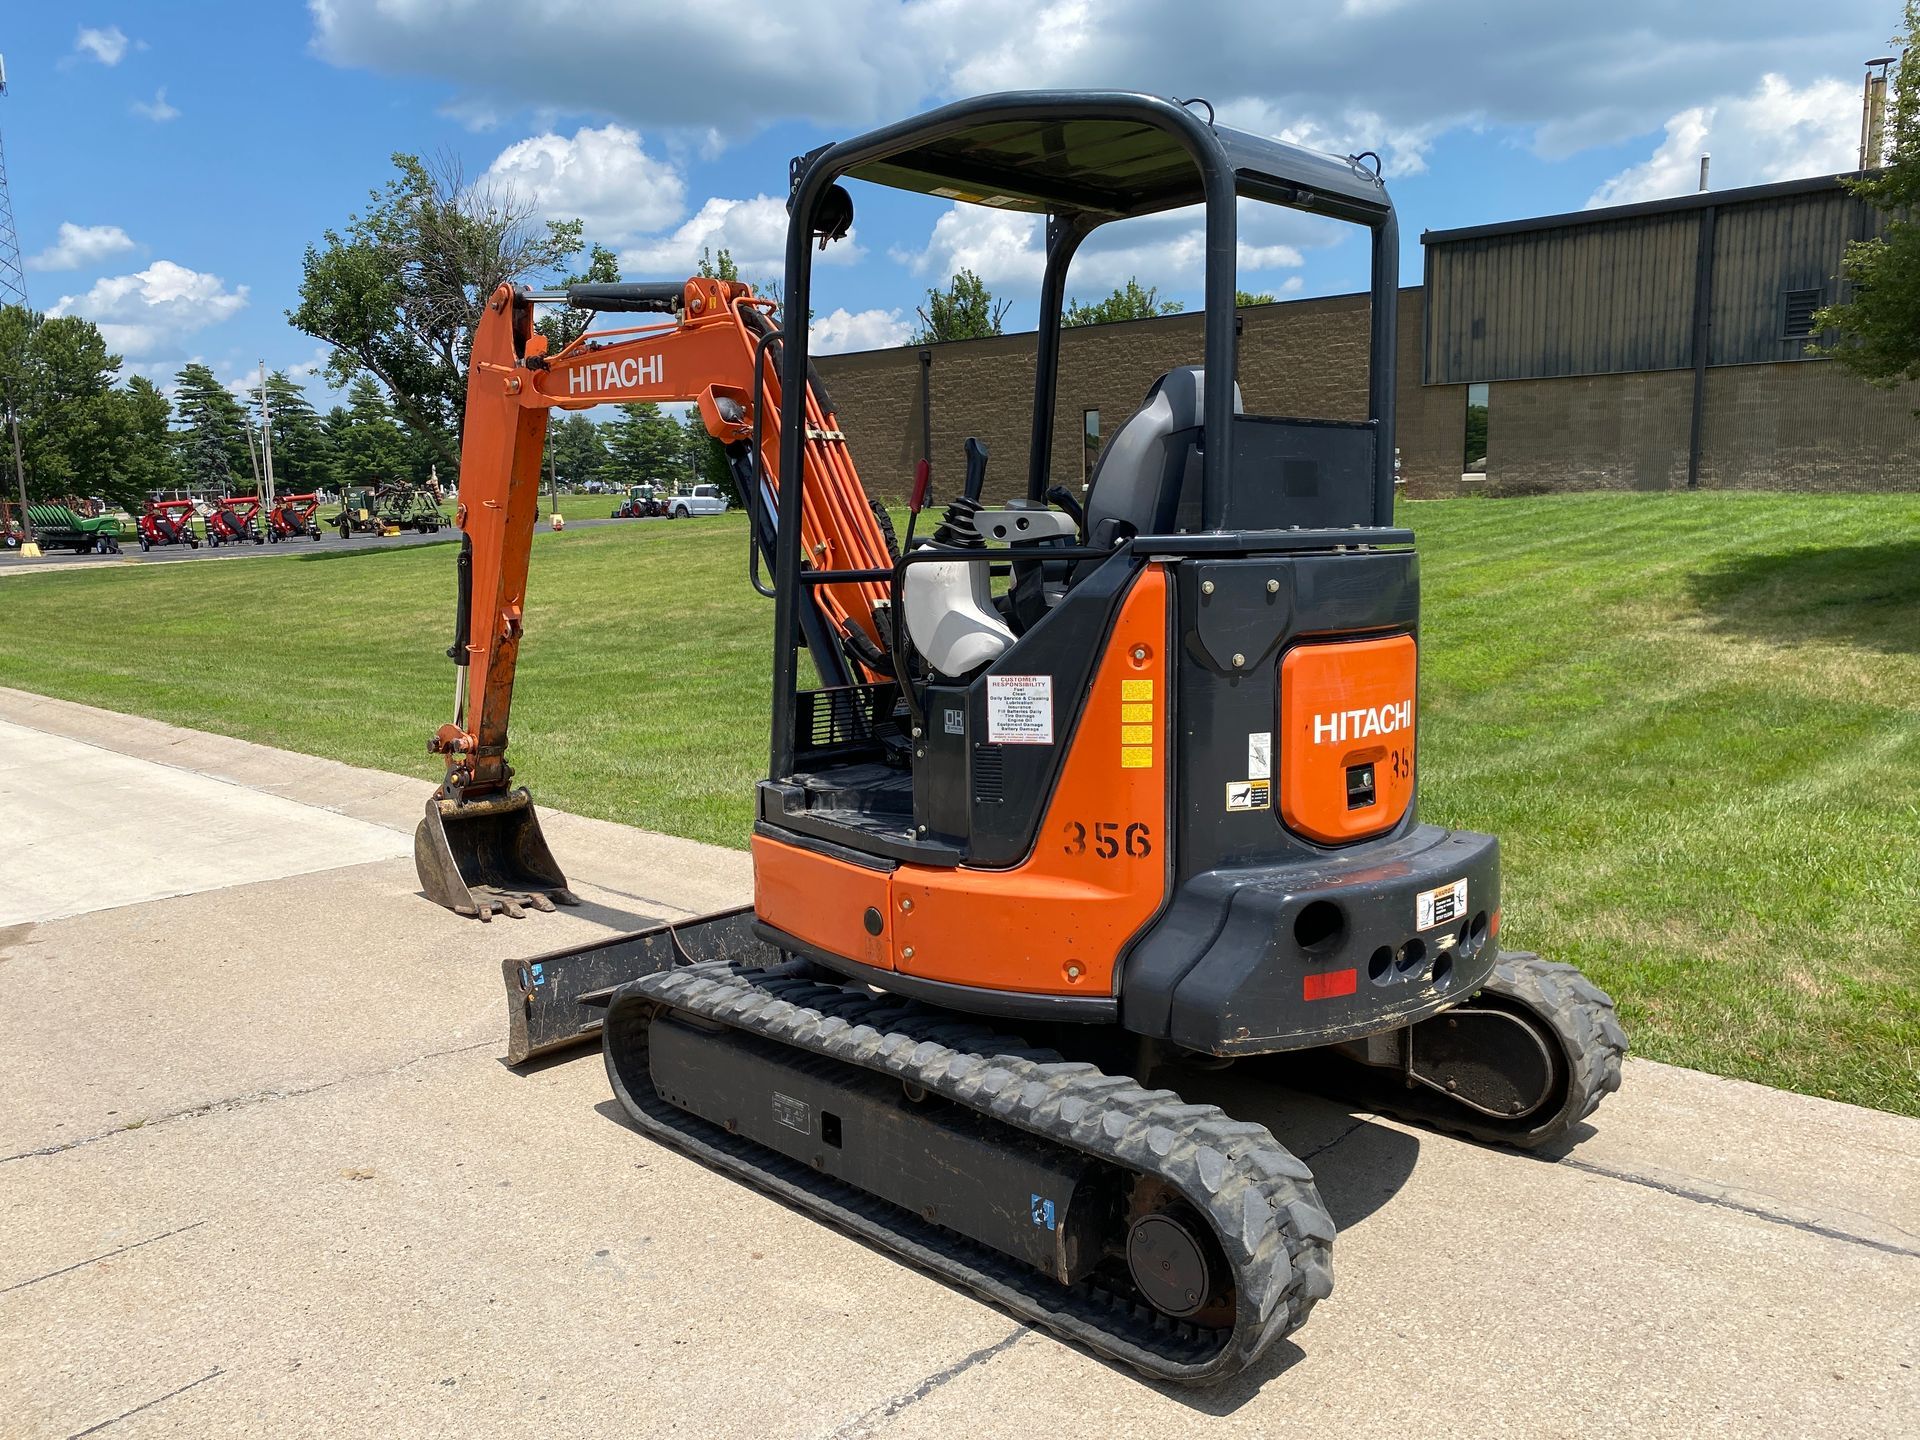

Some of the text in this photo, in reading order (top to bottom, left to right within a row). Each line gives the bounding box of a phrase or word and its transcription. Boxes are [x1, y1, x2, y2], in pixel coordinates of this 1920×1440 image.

[569, 355, 663, 394] HITACHI
[1313, 700, 1411, 744] HITACHI
[1392, 748, 1413, 779] 35
[1063, 821, 1152, 859] 356
